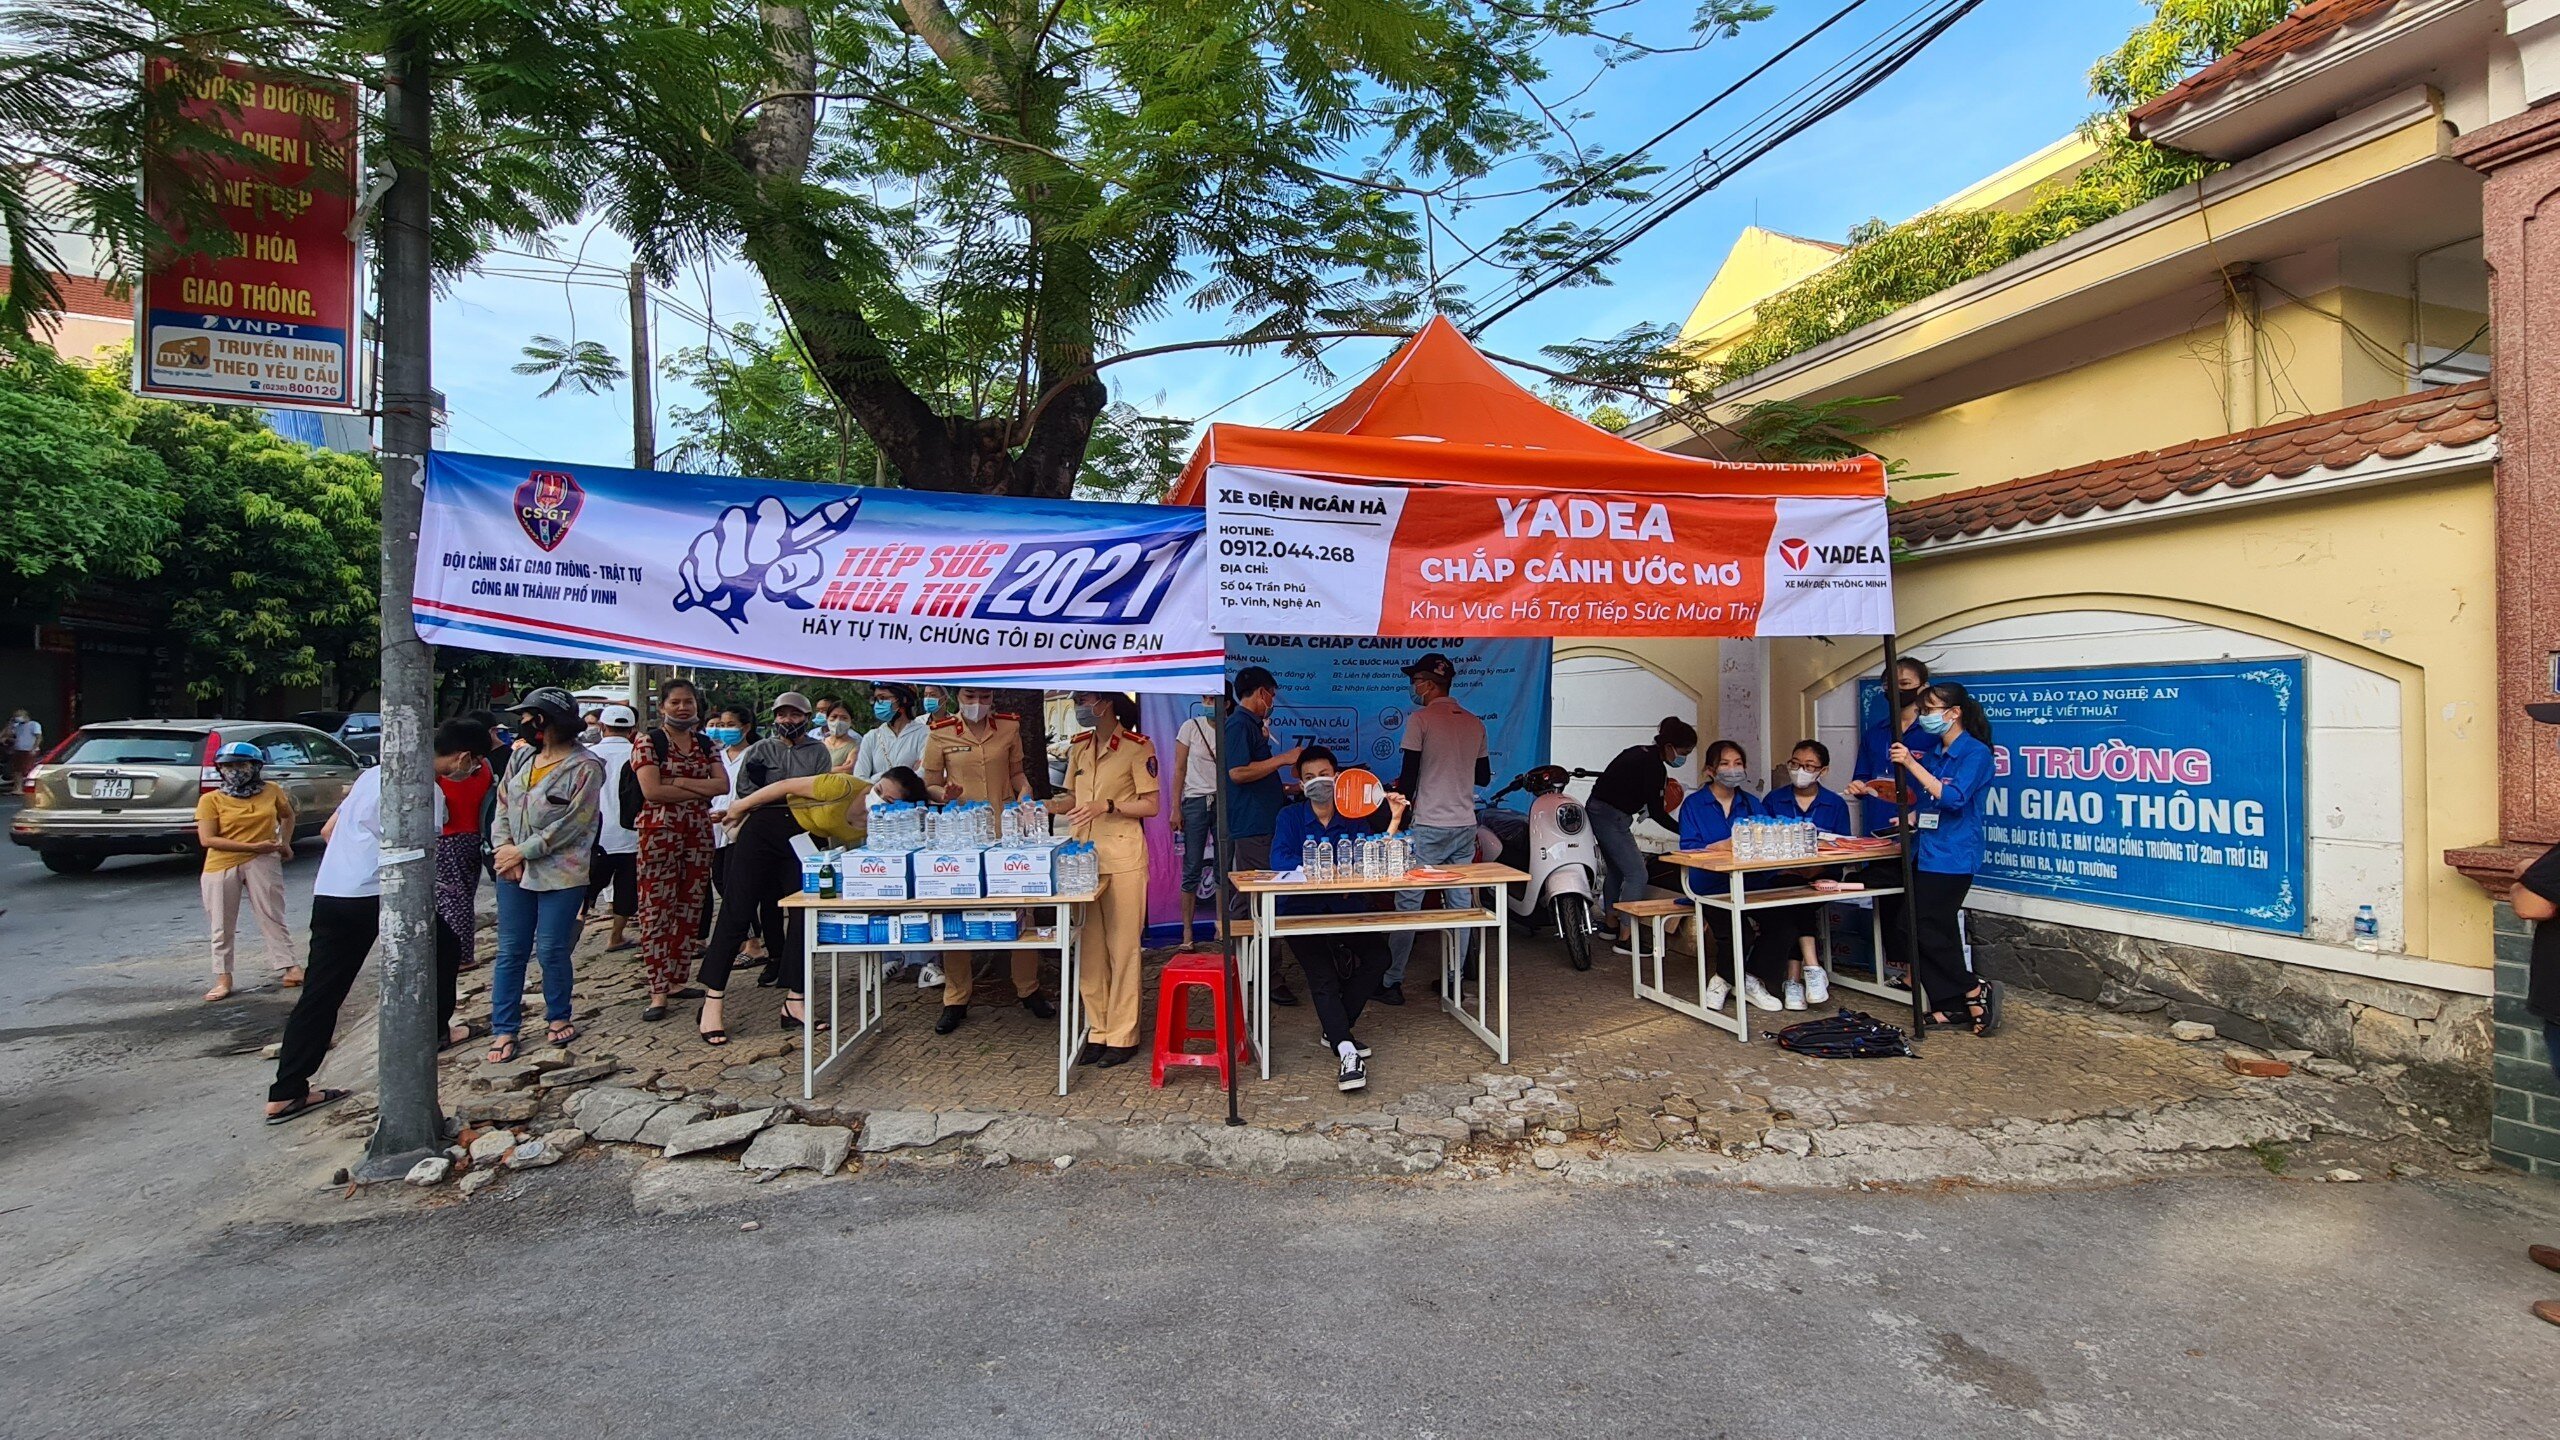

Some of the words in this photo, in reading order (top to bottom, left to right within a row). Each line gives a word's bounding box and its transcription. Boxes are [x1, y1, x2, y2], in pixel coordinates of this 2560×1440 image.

[256, 231, 299, 264] HÓA
[182, 277, 234, 307] GIAO
[240, 281, 317, 317] THÔNG.
[226, 318, 299, 336] VNPT
[292, 344, 336, 363] HÌNH
[213, 359, 259, 377] THEO
[265, 362, 298, 380] YÊU
[289, 383, 338, 396] 800126
[1218, 489, 1244, 504] XE
[1248, 491, 1294, 512] ĐIỆN
[1300, 495, 1355, 513] NGÂN
[1360, 498, 1387, 515] HÀ
[1495, 498, 1675, 543] YADEA
[1219, 525, 1275, 536] HOTLINE:
[1219, 539, 1355, 562] 0912.044.268
[1814, 546, 1885, 564] YADEA
[442, 551, 466, 571] ĐỘI
[468, 551, 497, 570] CẢNH
[500, 555, 522, 573] SÁT
[524, 558, 552, 575] GIAO
[555, 560, 591, 579] THÔNG
[600, 563, 626, 583] TRẬT
[628, 566, 643, 585] TỰ
[1220, 564, 1242, 575] ĐỊA
[1245, 562, 1268, 574] CHỈ:
[1420, 548, 1515, 583] CHẮP
[1524, 552, 1613, 583] CÁNH
[1622, 555, 1687, 585] ƯỚC
[1695, 559, 1741, 586] MƠ
[835, 542, 923, 577] TIẾP
[924, 539, 1009, 578] SỨC
[987, 541, 1183, 618] 2021
[1220, 580, 1235, 591] Số
[1238, 582, 1253, 592] 04
[1284, 583, 1306, 593] Phú
[1785, 580, 1796, 588] XE
[1832, 578, 1863, 588] THÔNG
[1865, 580, 1887, 588] MINH
[471, 578, 501, 597] CÔNG
[504, 583, 519, 597] AN
[523, 582, 561, 600] THÀNH
[563, 584, 587, 602] PHỐ
[591, 589, 617, 605] VINH
[818, 578, 900, 613] MÙA
[911, 583, 982, 618] THI
[1221, 597, 1238, 607] Tp.
[1240, 597, 1270, 608] Vinh,
[1273, 598, 1303, 609] Nghệ
[1305, 600, 1321, 608] An
[1409, 600, 1455, 619] Khu
[1461, 602, 1504, 622] Vực
[1511, 598, 1541, 619] Hỗ
[1548, 602, 1581, 625] Trợ
[1585, 600, 1628, 624] Tiếp
[1633, 601, 1671, 620] Sức
[1677, 601, 1722, 620] Mùa
[1727, 601, 1755, 620] Thi
[802, 615, 841, 637] HÃY
[847, 619, 875, 640] TỰ
[878, 623, 913, 644] TIN,
[919, 621, 990, 646] CHÚNG
[998, 625, 1028, 648] TÔI
[1033, 633, 1054, 649] ĐI
[1059, 629, 1116, 650] CÙNG
[1122, 633, 1164, 654] BẠN
[1244, 634, 1303, 648] YADEA
[1333, 658, 1340, 666] 2.
[1341, 657, 1358, 666] CÁC
[1359, 657, 1382, 666] BƯỚC
[1979, 692, 2006, 705] DỤC
[2009, 690, 2028, 702] VÀ
[2033, 689, 2064, 702] ĐÀO
[2067, 690, 2099, 703] TẠO
[2103, 686, 2149, 701] NGHỆ
[2153, 687, 2180, 699] AN
[2015, 707, 2039, 717] THPT
[2041, 705, 2053, 717] LÊ
[2056, 704, 2078, 716] VIẾT
[2081, 703, 2118, 718] THUẬT
[1300, 717, 1326, 727] TOÀN
[1329, 716, 1349, 727] CẦU
[2019, 738, 2211, 785] TRƯỜNG
[95, 788, 129, 797] 01167
[104, 780, 122, 788] 37A
[2020, 788, 2104, 824] GIAO
[2116, 789, 2264, 837] THÔNG
[2011, 827, 2026, 848] ĐẬU
[2028, 830, 2039, 847] XE
[2040, 828, 2045, 848] Ô
[2047, 828, 2060, 850] TÔ,
[2061, 832, 2072, 850] XE
[2073, 831, 2092, 852] MÁY
[2094, 832, 2117, 854] CÁCH
[2119, 832, 2144, 857] CỔNG
[2145, 837, 2183, 861] TRƯỜNG
[2185, 841, 2199, 863] TỪ
[2200, 846, 2222, 865] 20m
[2224, 841, 2245, 867] TRỞ
[2248, 846, 2268, 869] LÊN
[860, 863, 887, 874] laVie
[934, 862, 960, 872] laVie
[1004, 860, 1030, 871] laVie
[1994, 847, 2018, 867] CỔNG
[2020, 854, 2036, 869] KHI
[2038, 857, 2053, 873] RA,
[2055, 854, 2075, 874] VÀO
[2077, 859, 2117, 879] TRƯỜNG
